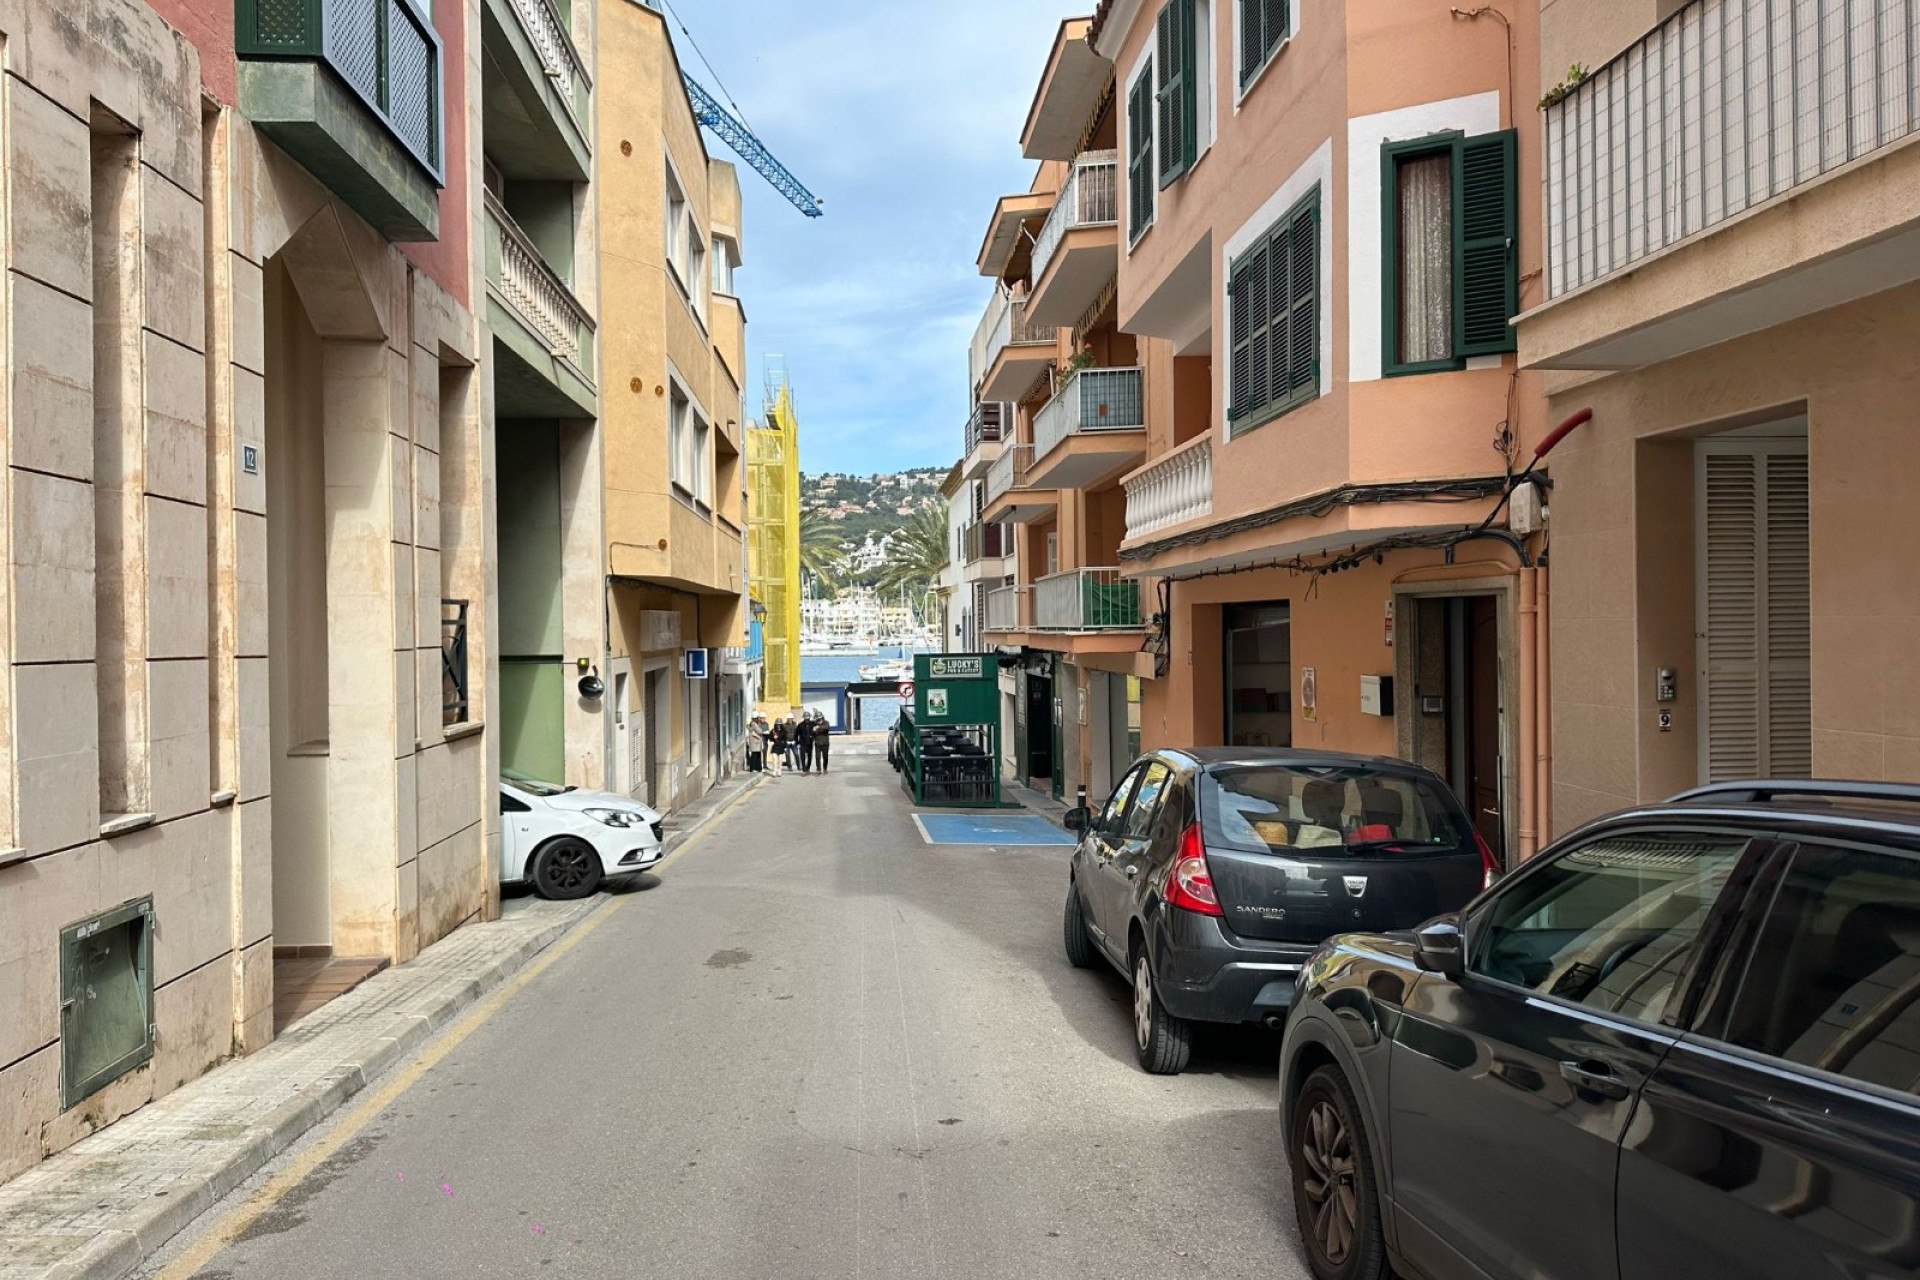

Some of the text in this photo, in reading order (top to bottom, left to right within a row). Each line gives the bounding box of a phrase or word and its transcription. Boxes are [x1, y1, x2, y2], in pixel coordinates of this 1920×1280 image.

[246, 450, 254, 467] 12
[689, 652, 703, 675] L
[947, 659, 979, 669] LUCKY'S
[1660, 714, 1670, 726] 9
[1236, 905, 1286, 914] SANDERO
